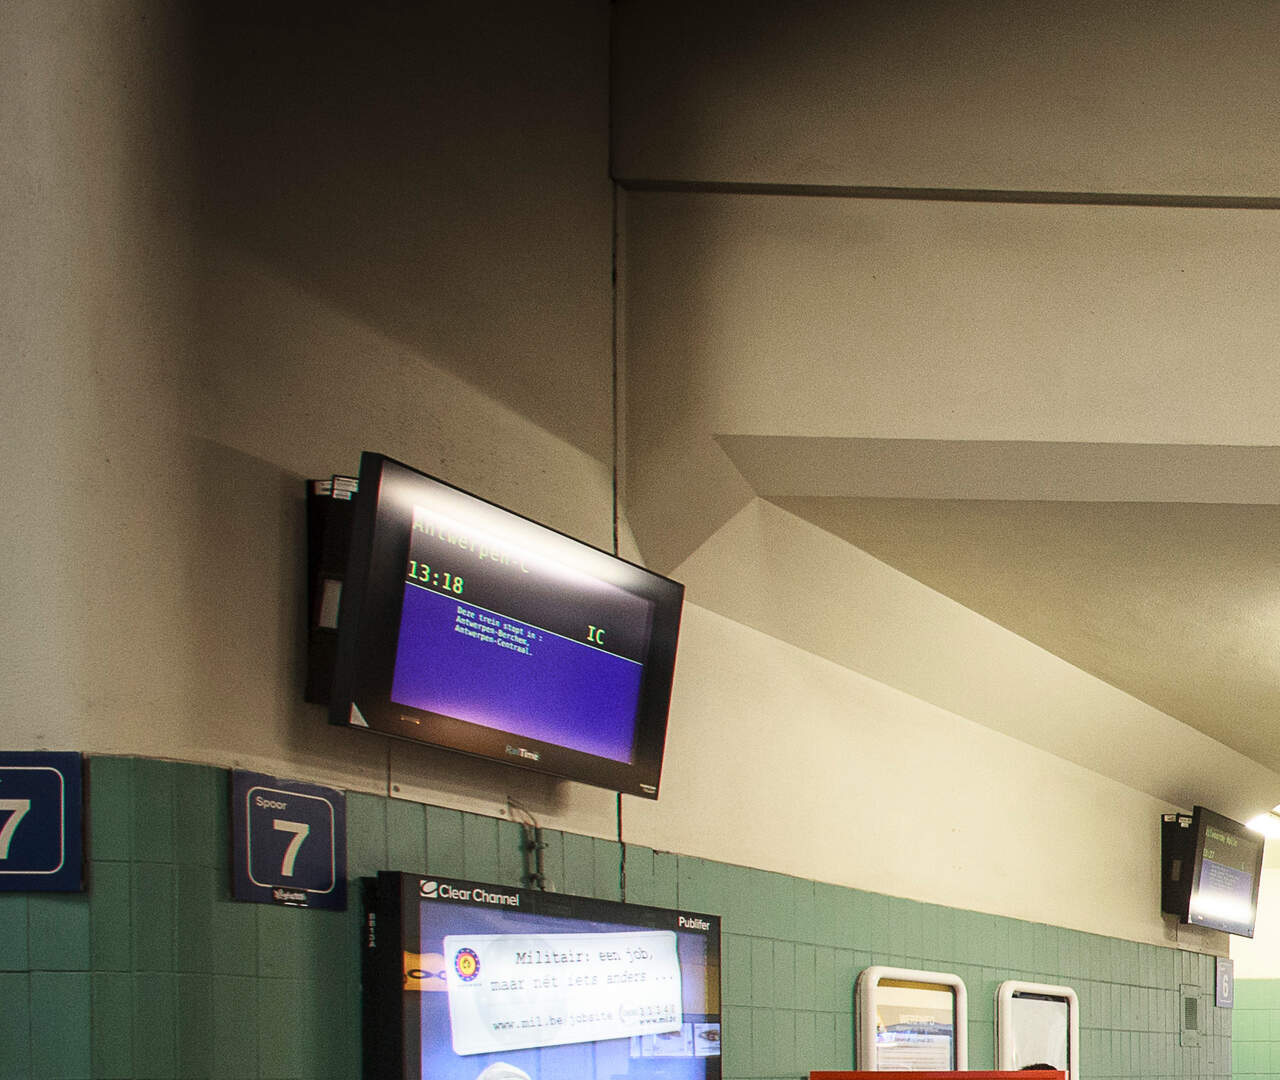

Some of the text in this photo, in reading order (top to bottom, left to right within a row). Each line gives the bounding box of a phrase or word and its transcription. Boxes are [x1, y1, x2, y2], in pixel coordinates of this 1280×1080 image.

[408, 560, 464, 594] 13:18
[587, 625, 605, 645] IC
[256, 796, 287, 810] Spoor
[0, 799, 31, 859] 7
[273, 819, 310, 877] 7
[439, 884, 520, 907] Clear Channel
[678, 916, 711, 931] Publifer
[515, 949, 590, 965] Militair:
[599, 950, 621, 962] een
[490, 977, 525, 992] maar
[568, 974, 599, 987] iets
[606, 970, 647, 985] anders
